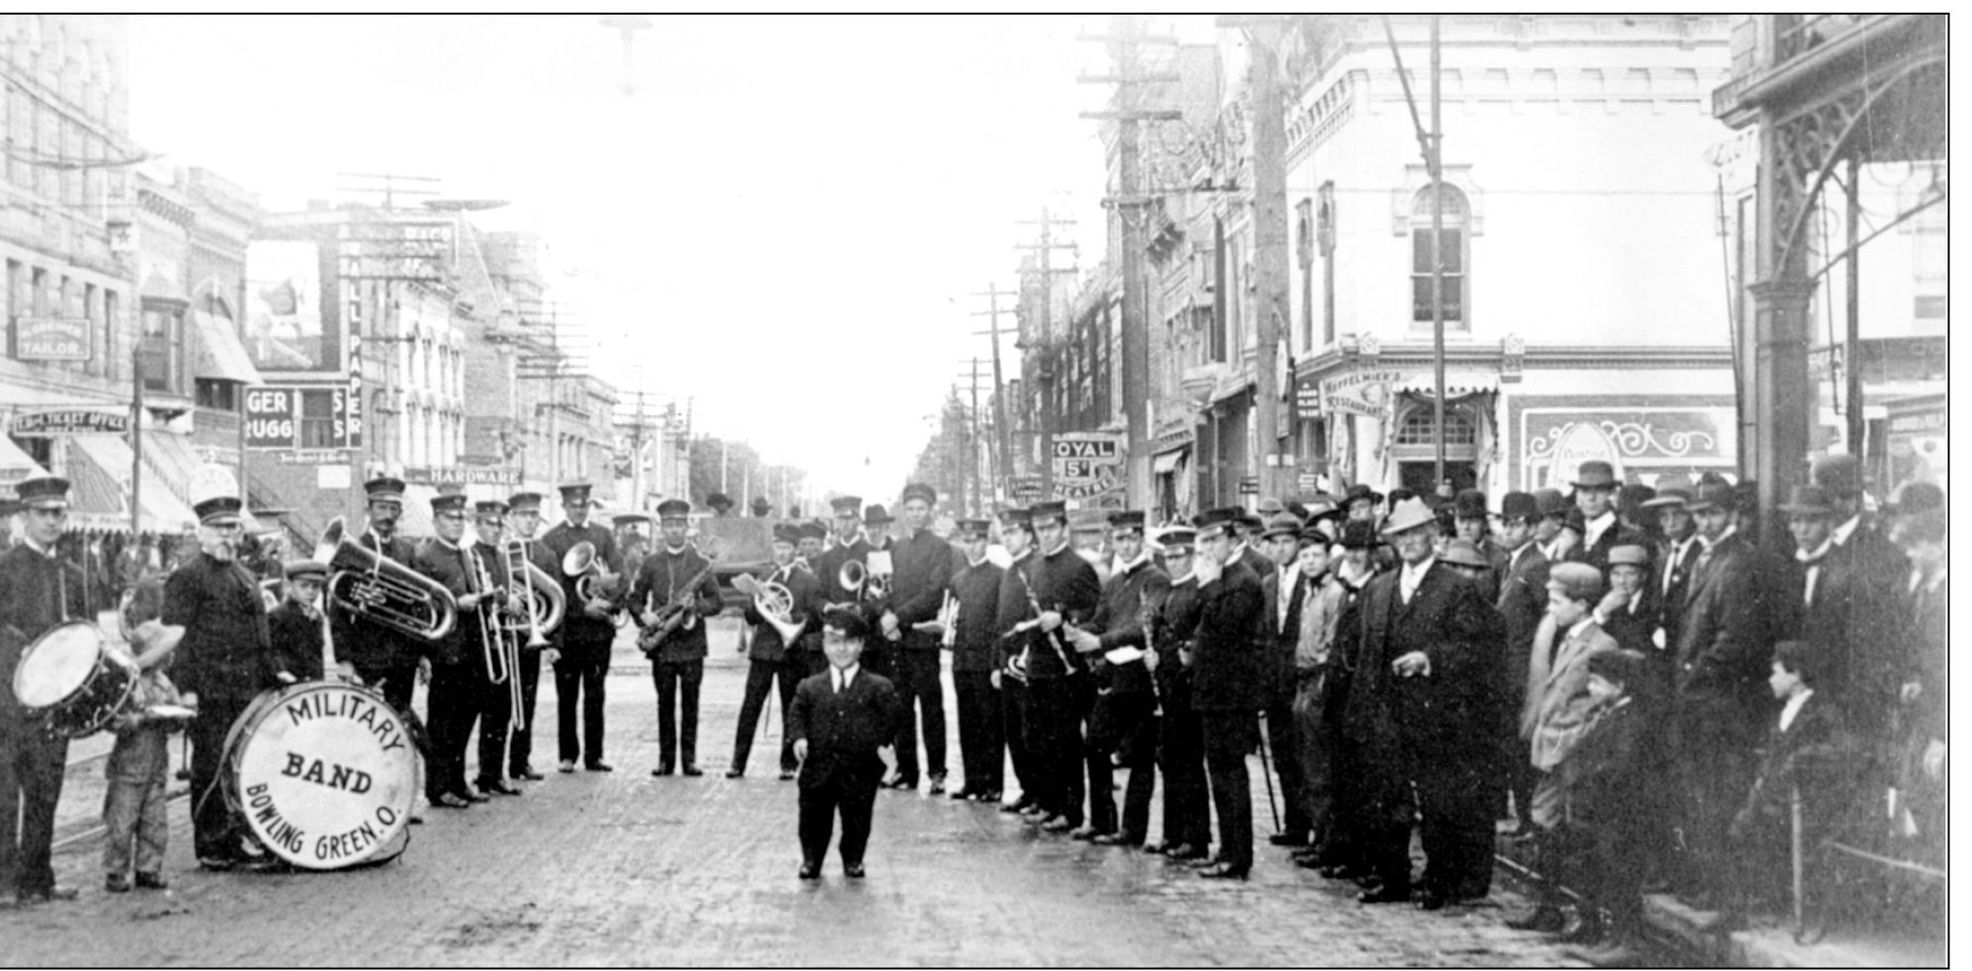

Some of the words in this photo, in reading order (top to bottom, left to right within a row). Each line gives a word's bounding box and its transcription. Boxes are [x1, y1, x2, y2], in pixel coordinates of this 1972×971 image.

[350, 334, 361, 434] PAPER
[247, 391, 287, 413] GER
[1052, 441, 1113, 457] OYAL
[431, 470, 519, 483] HARDWARE
[1053, 477, 1110, 498] HEATRE
[286, 693, 405, 752] MILITARY
[281, 751, 372, 795] BAND
[246, 783, 305, 854] BOWLING
